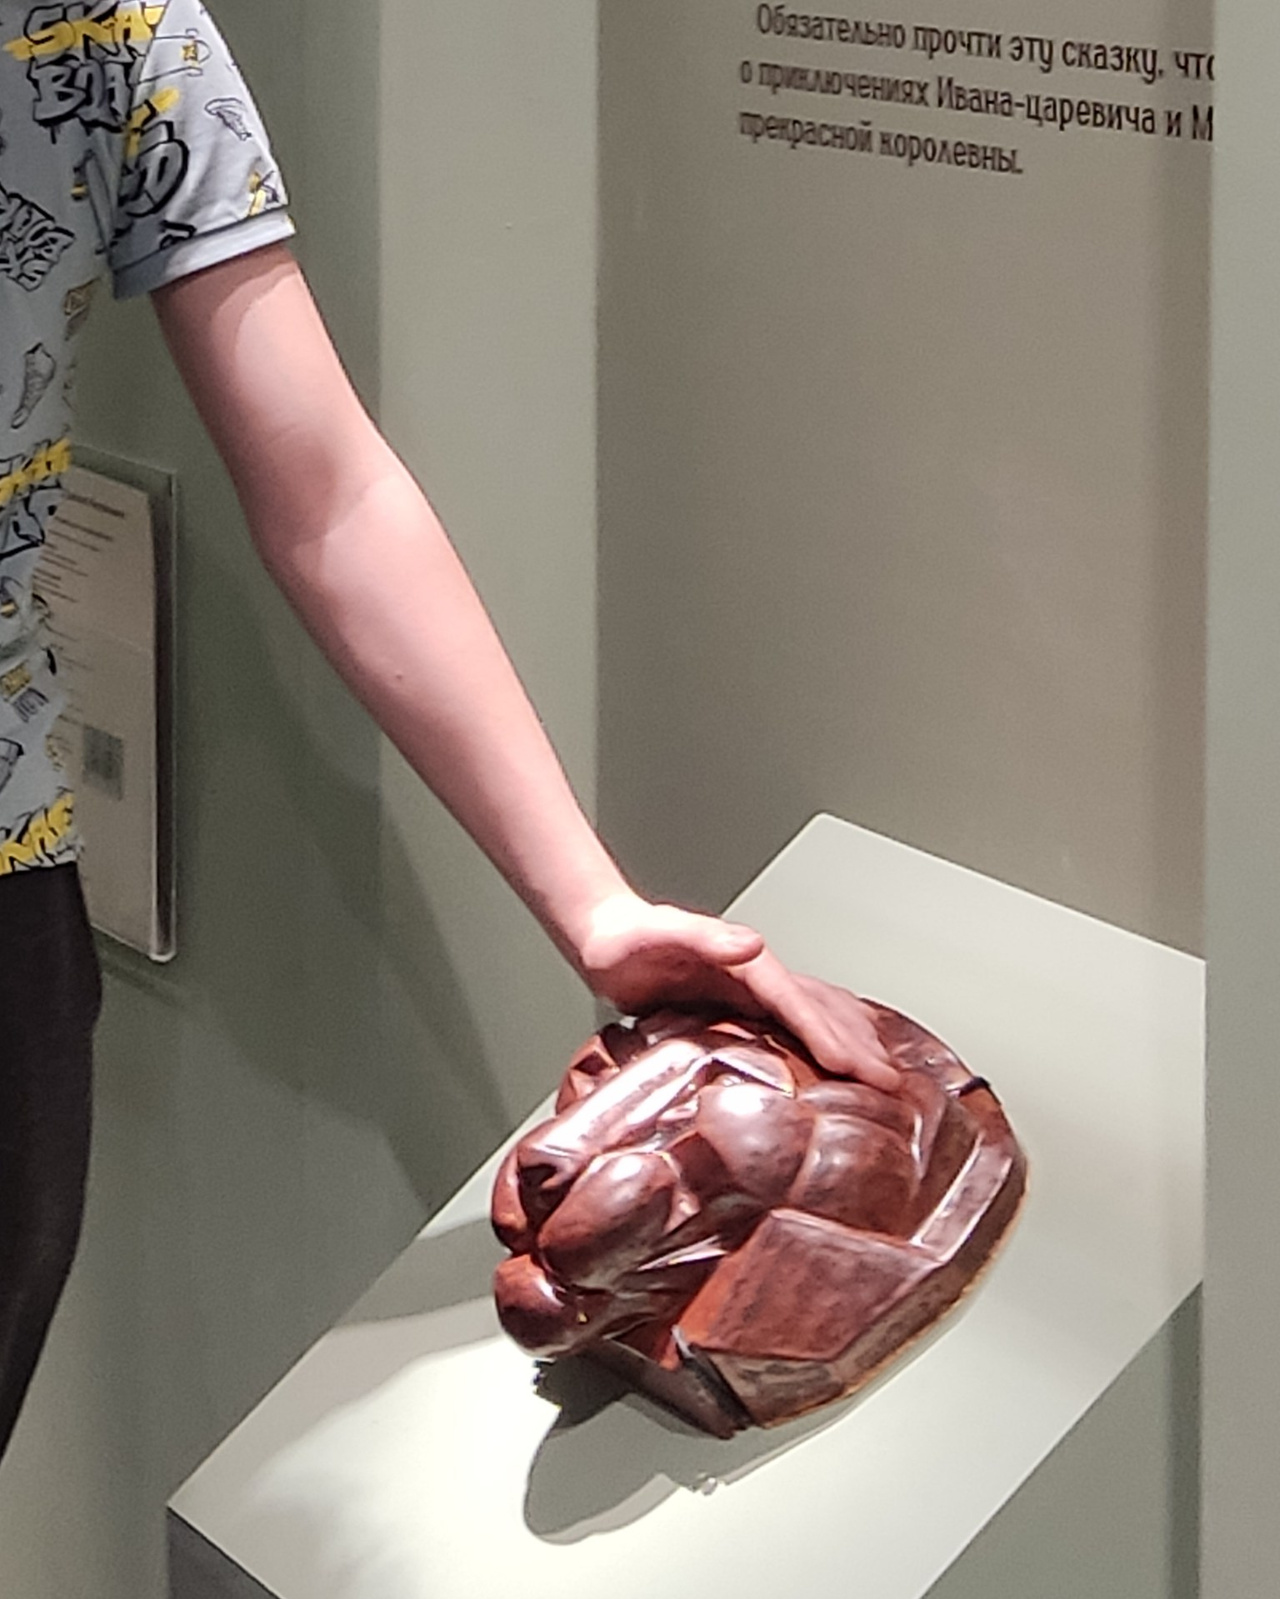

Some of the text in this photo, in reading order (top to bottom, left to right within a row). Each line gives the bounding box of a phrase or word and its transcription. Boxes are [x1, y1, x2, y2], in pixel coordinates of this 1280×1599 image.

[755, 2, 908, 50] Обязательно
[909, 25, 1003, 61] прочти
[1007, 34, 1056, 75] эту
[738, 59, 754, 85] о
[757, 61, 931, 108] приключениях
[935, 74, 1158, 136] Ивана-царевича
[1163, 109, 1184, 139] и
[738, 111, 1025, 175] прекрасной королевны.
